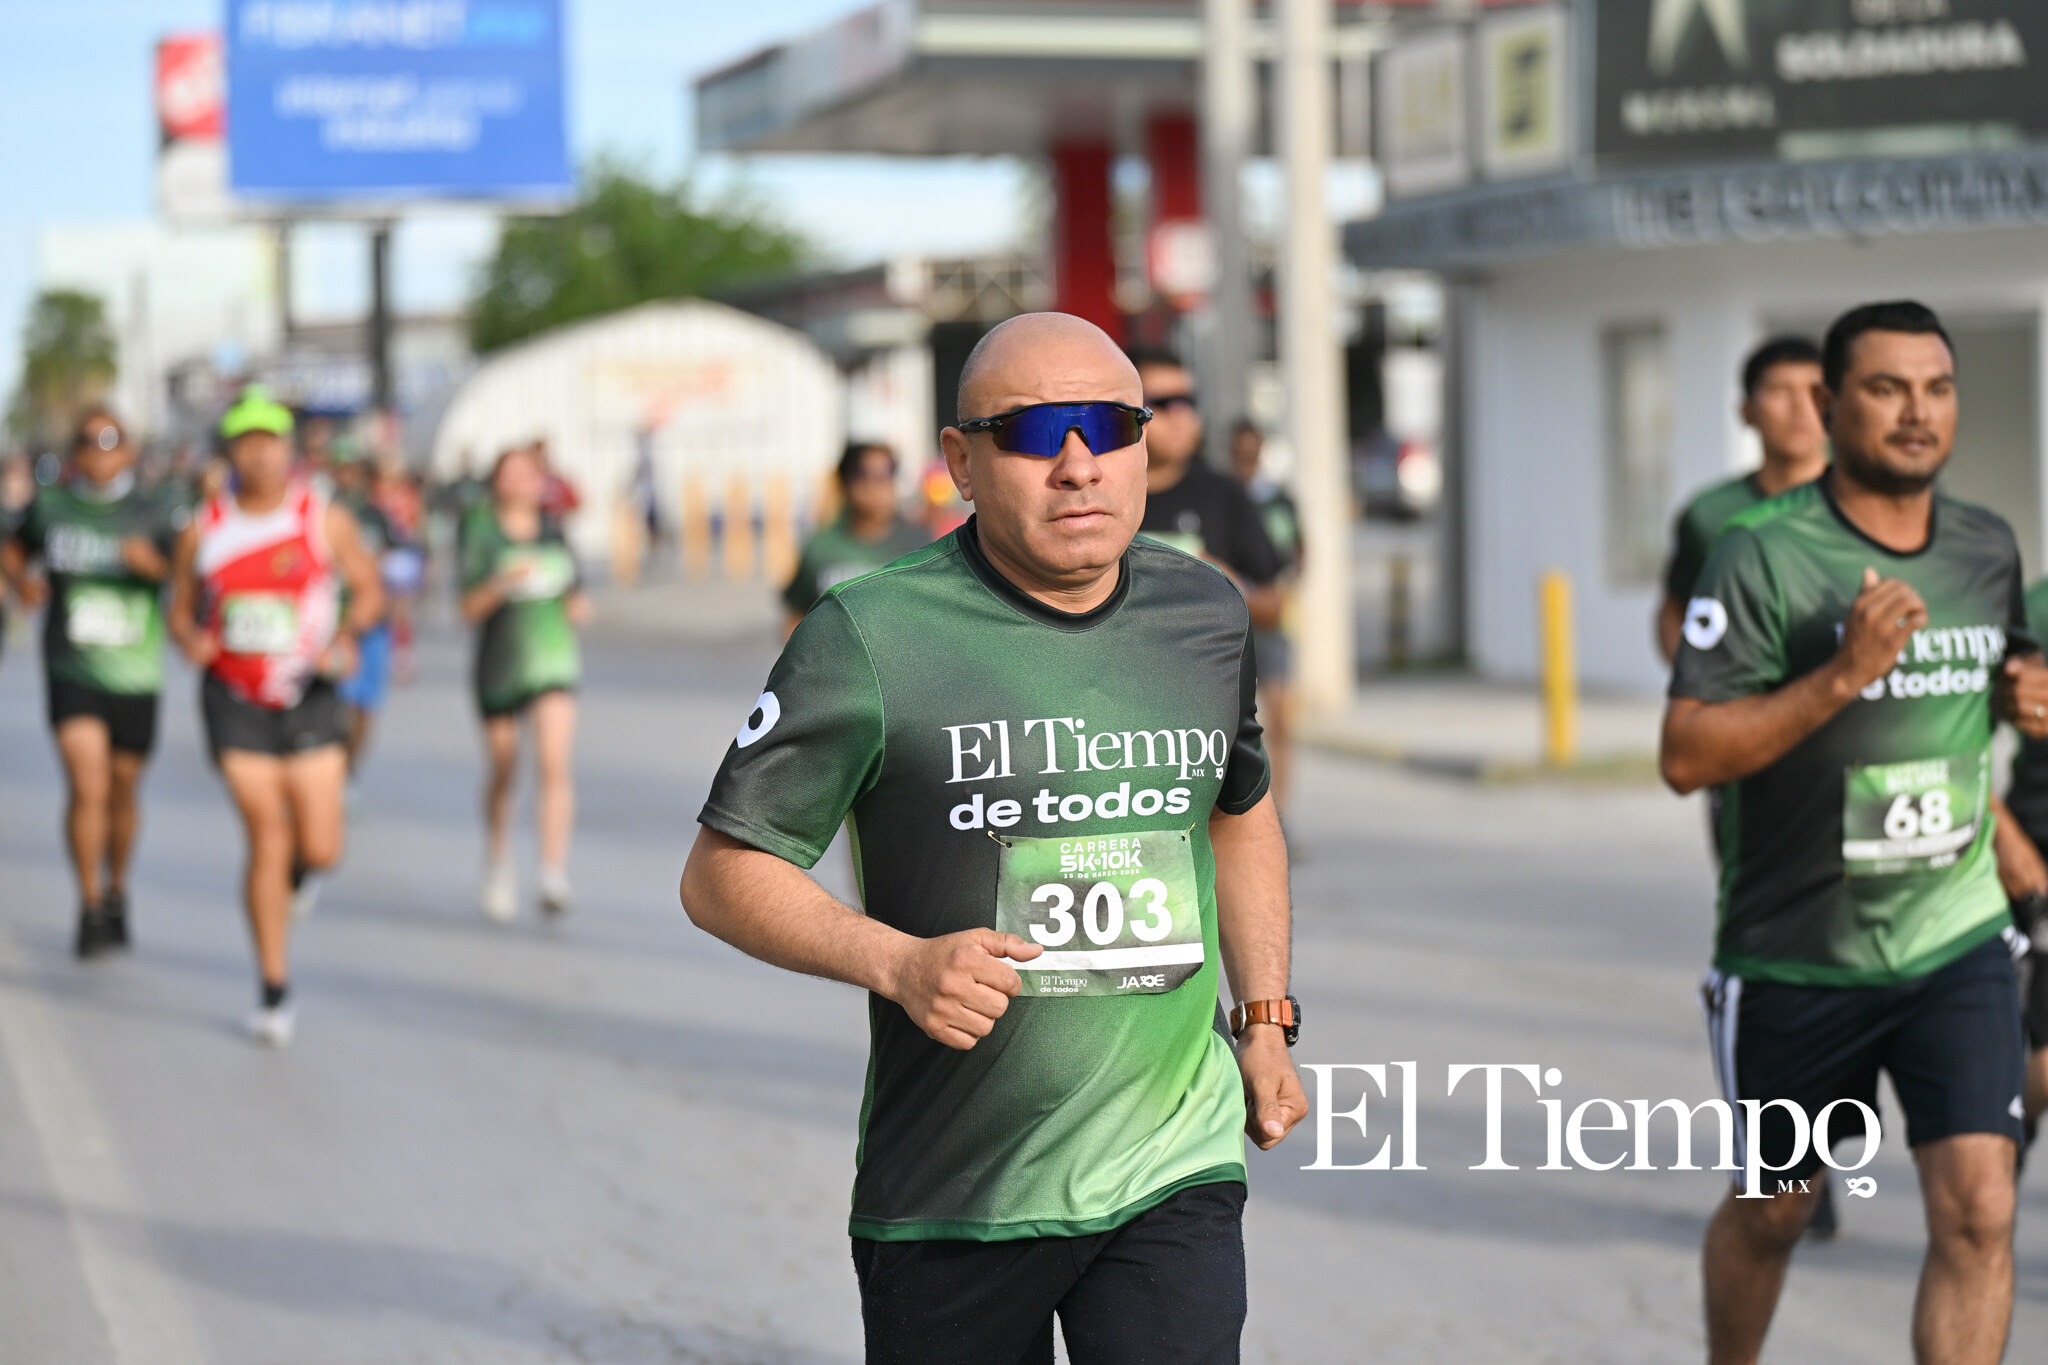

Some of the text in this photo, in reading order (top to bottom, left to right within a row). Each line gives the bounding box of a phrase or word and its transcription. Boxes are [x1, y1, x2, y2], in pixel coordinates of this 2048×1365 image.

[1888, 665, 1989, 699] todos
[942, 717, 1228, 784] El Tiempo
[1192, 768, 1205, 777] MX
[949, 781, 1192, 831] de todos
[1883, 789, 1953, 840] 68
[1060, 837, 1142, 854] CARRERA
[1092, 869, 1117, 878] MARZO
[1028, 877, 1173, 947] 303
[1040, 975, 1088, 987] El Tiempo
